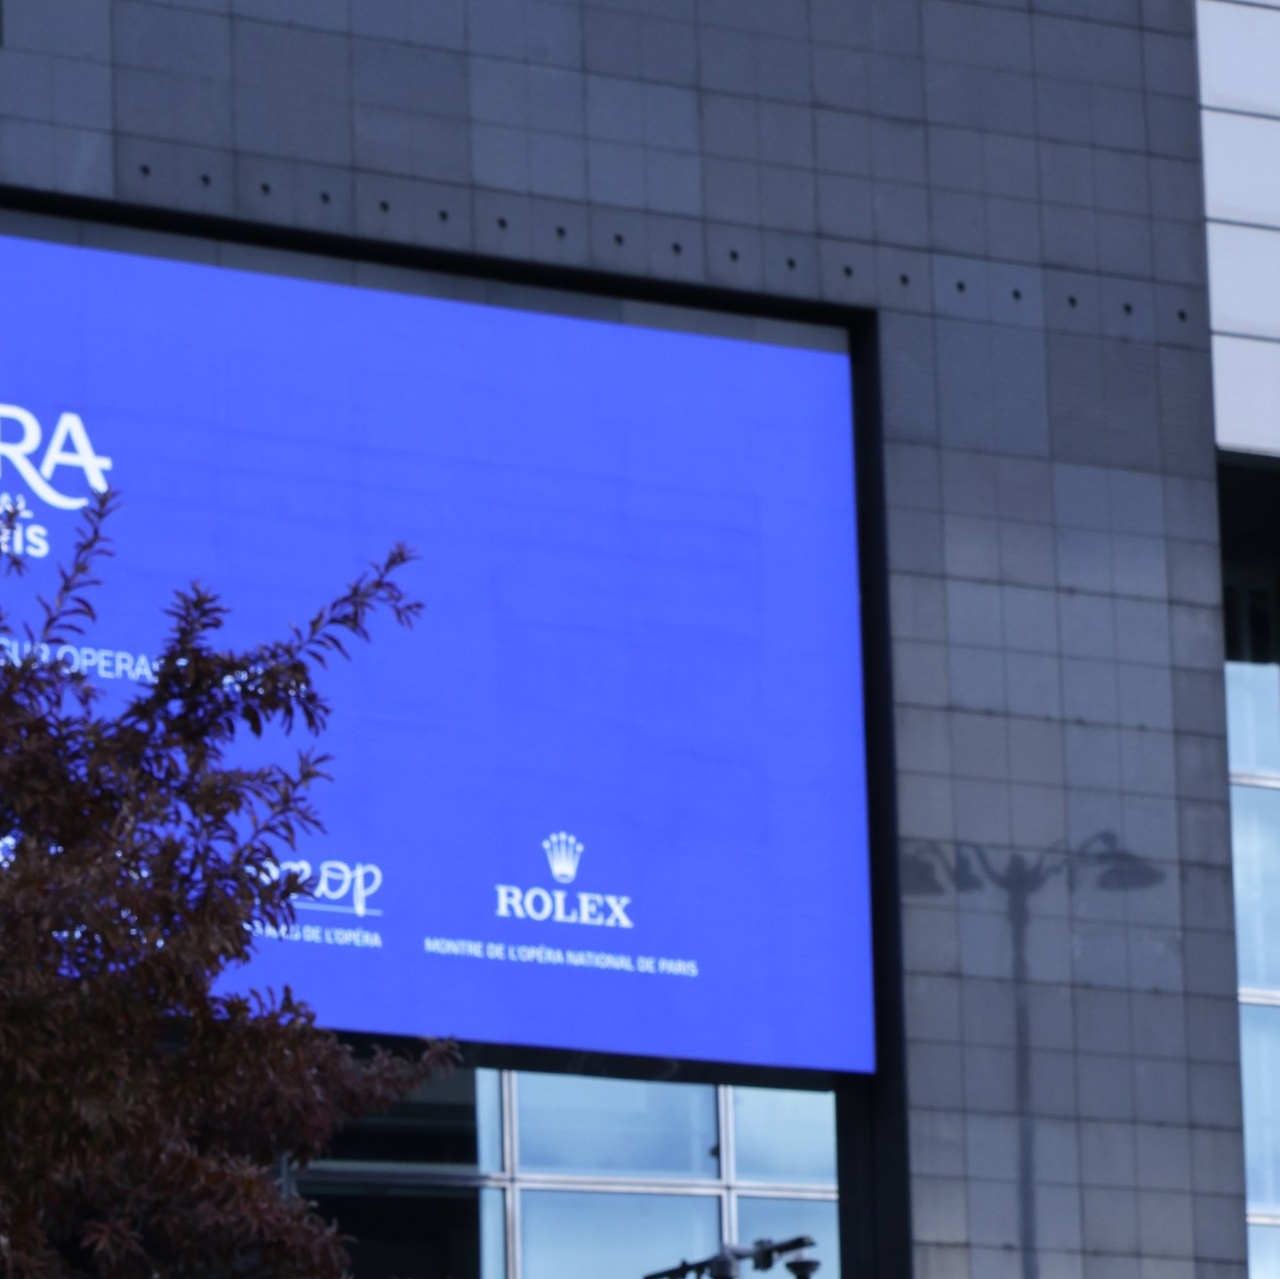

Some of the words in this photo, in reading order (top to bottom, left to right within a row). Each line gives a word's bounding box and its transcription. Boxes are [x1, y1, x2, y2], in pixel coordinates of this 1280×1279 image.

[494, 884, 634, 929] ROLEX
[424, 937, 484, 958] MONTRE
[486, 942, 506, 961] DE
[565, 950, 635, 972] NATIONAL
[637, 956, 657, 974] DE
[658, 958, 699, 978] PARIS
